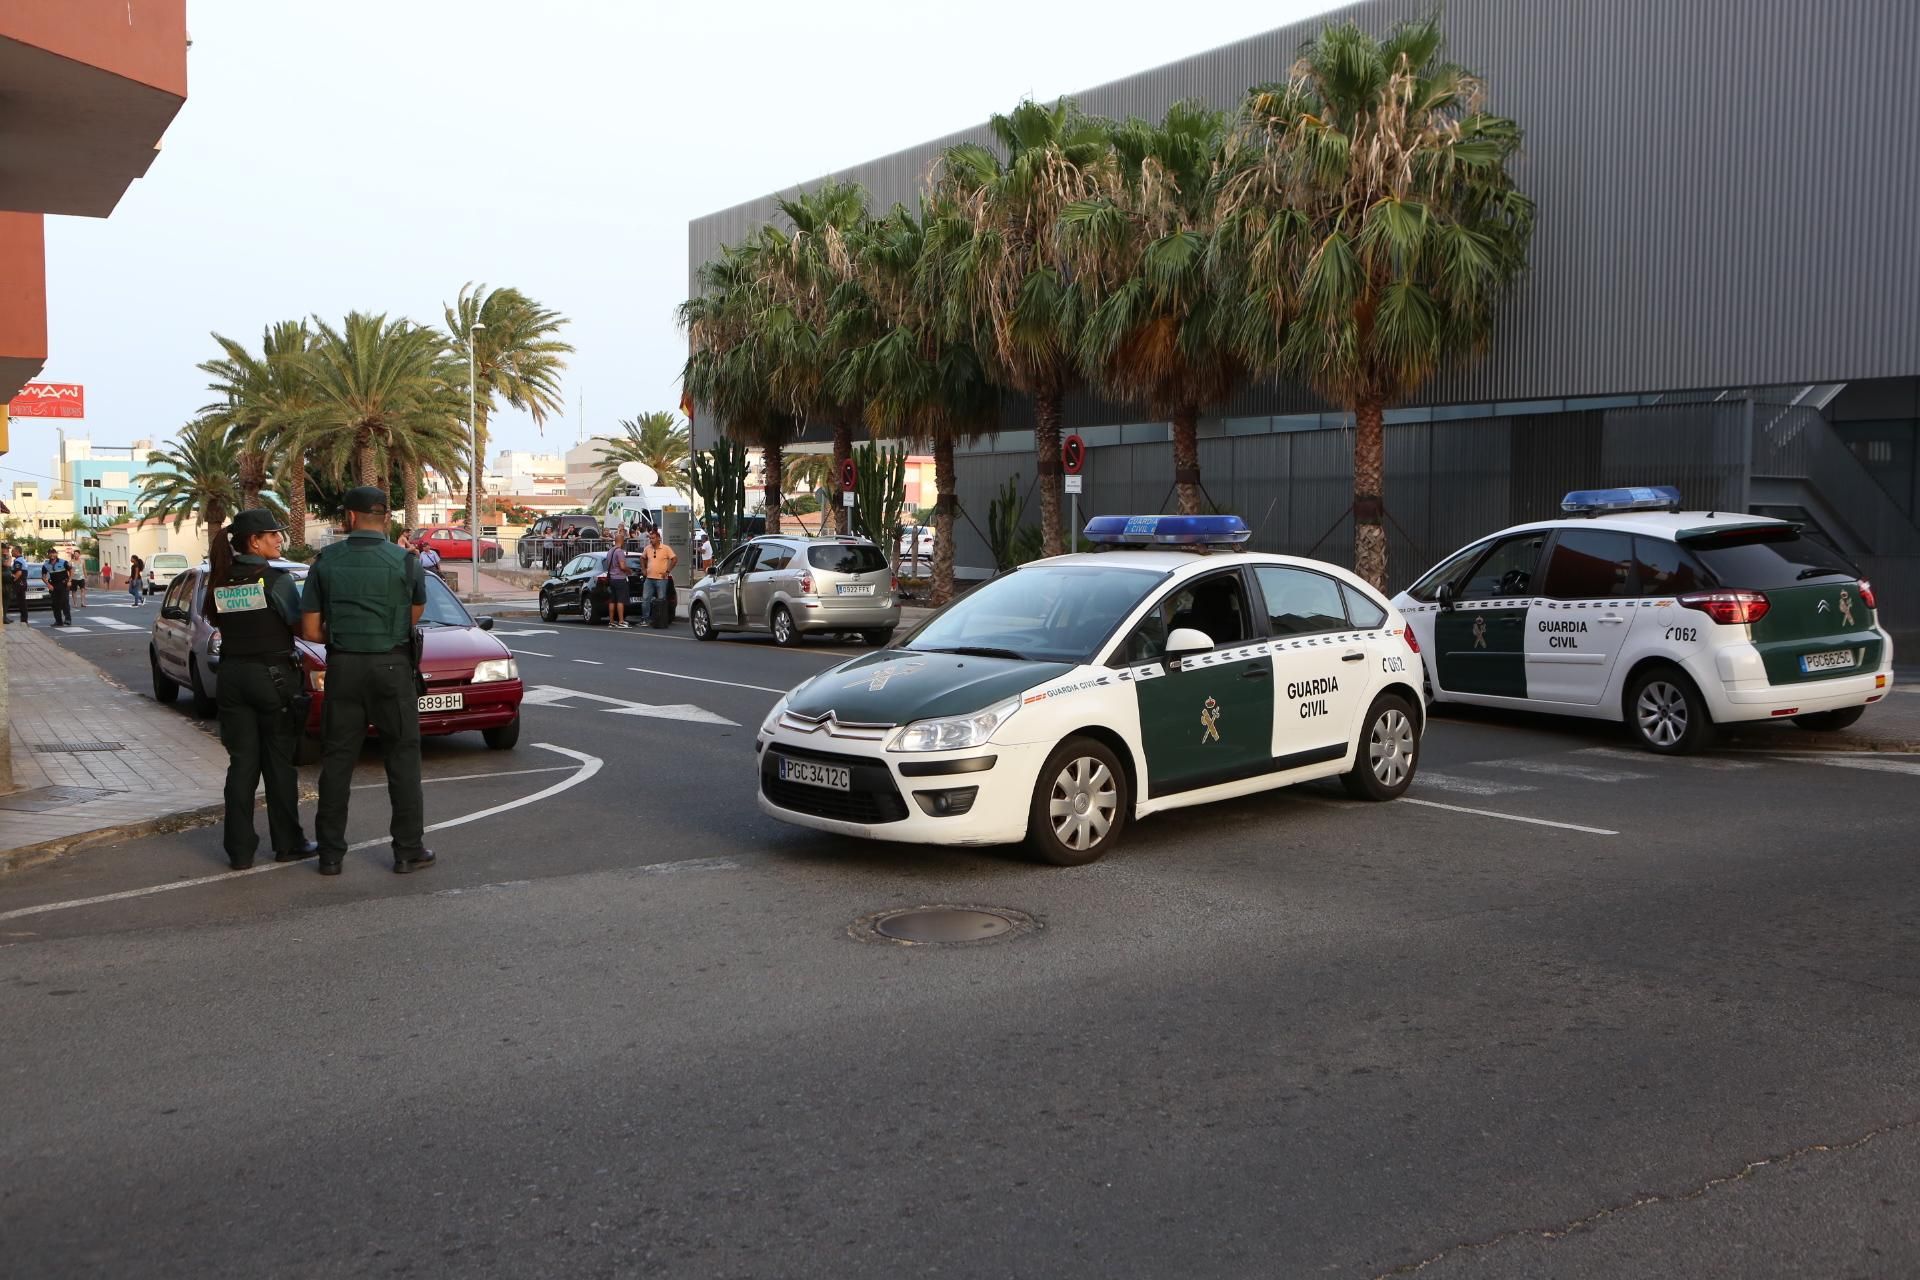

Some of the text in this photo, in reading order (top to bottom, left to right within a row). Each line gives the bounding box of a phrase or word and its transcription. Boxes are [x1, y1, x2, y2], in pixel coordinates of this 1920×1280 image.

[216, 587, 261, 600] GUARDIA
[226, 599, 252, 609] CIVIL
[1538, 621, 1588, 633] GUARDIA
[1674, 627, 1697, 642] 062
[1549, 636, 1578, 648] CIVIL
[1387, 656, 1406, 673] 062
[1806, 651, 1851, 667] PGC6625C
[1046, 680, 1098, 698] GUARDIA CIVIL
[1287, 676, 1339, 699] GUARDIA
[1300, 699, 1328, 718] CIVIL
[787, 761, 848, 788] PGC3412C
